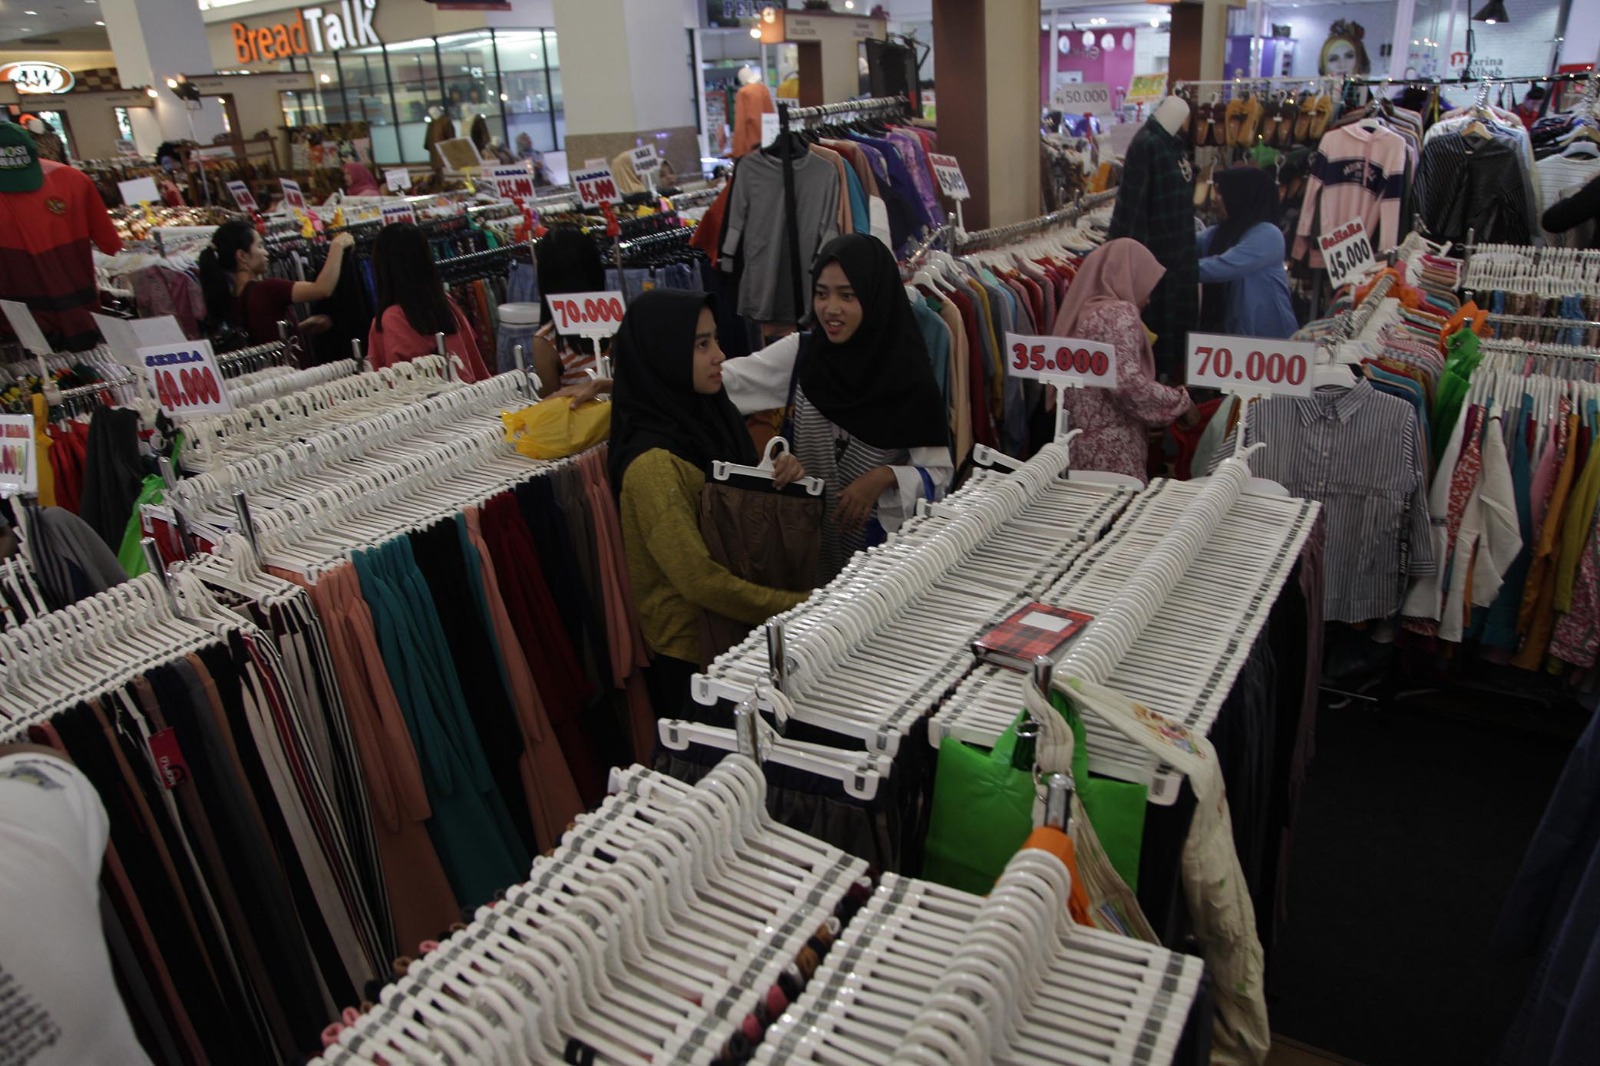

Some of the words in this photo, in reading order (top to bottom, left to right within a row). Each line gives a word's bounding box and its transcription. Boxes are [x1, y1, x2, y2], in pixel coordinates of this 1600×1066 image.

[231, 0, 379, 64] BreadTalk
[1066, 89, 1108, 103] 50.000
[1330, 237, 1370, 280] 45.000
[552, 297, 623, 328] 70.000
[145, 350, 205, 367] SERBA
[1011, 342, 1110, 377] 35.000
[1194, 345, 1307, 386] 70.000
[155, 366, 221, 412] 40.000
